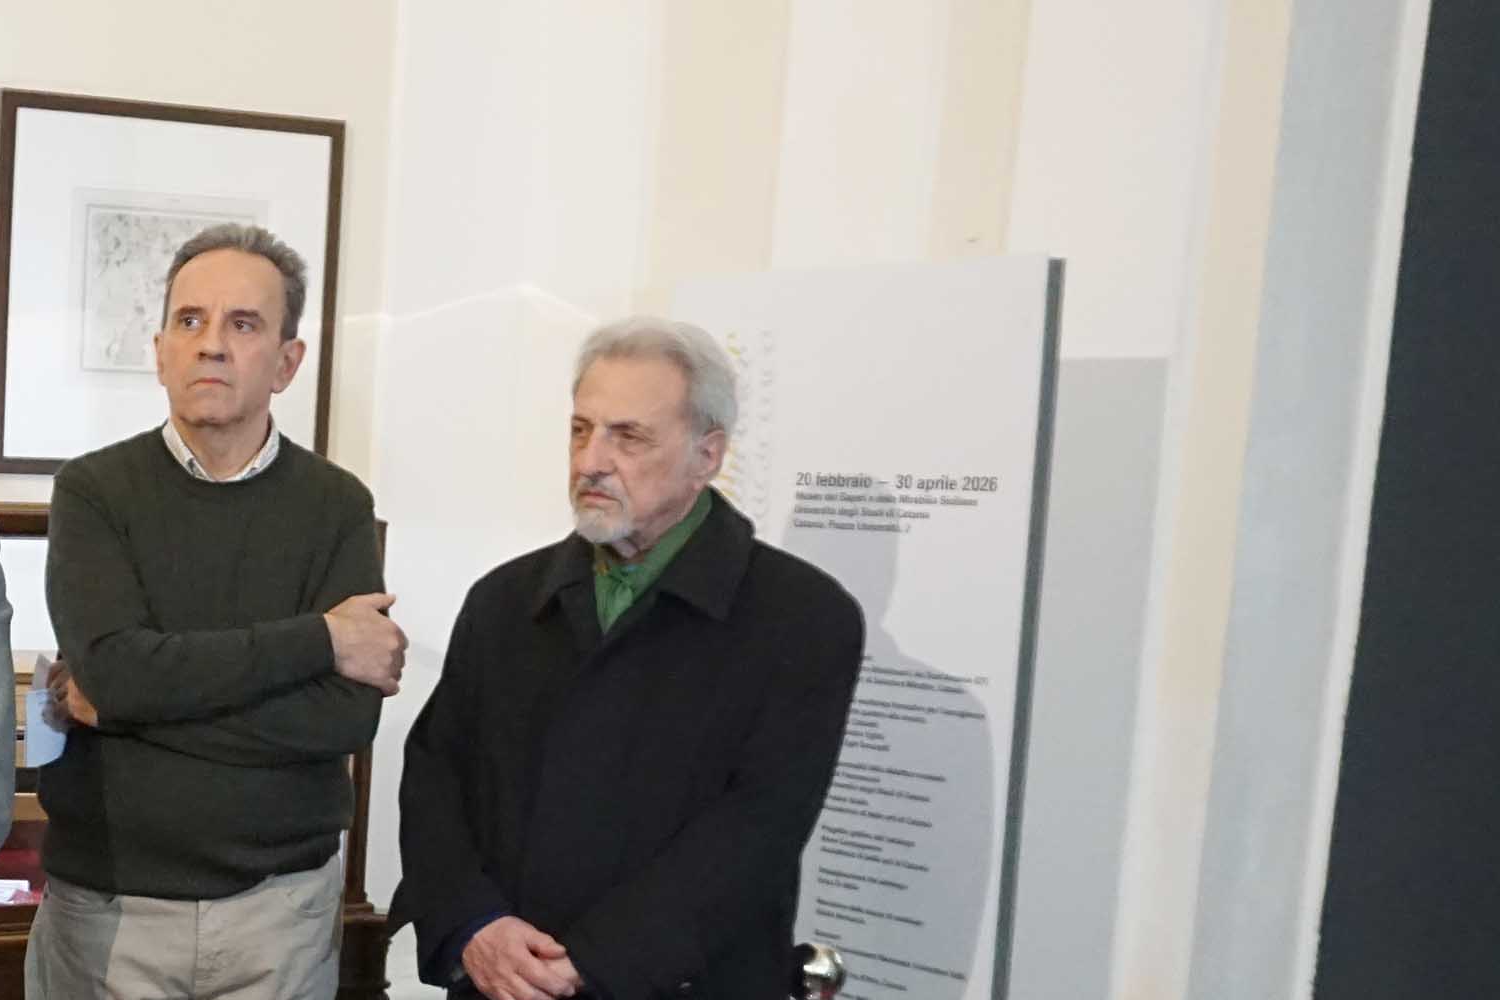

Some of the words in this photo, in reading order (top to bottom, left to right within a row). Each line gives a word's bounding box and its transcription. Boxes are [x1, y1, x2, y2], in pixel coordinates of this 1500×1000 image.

[796, 472, 812, 486] 20
[895, 473, 913, 489] 30
[916, 474, 958, 492] aprile
[962, 476, 998, 491] 2026
